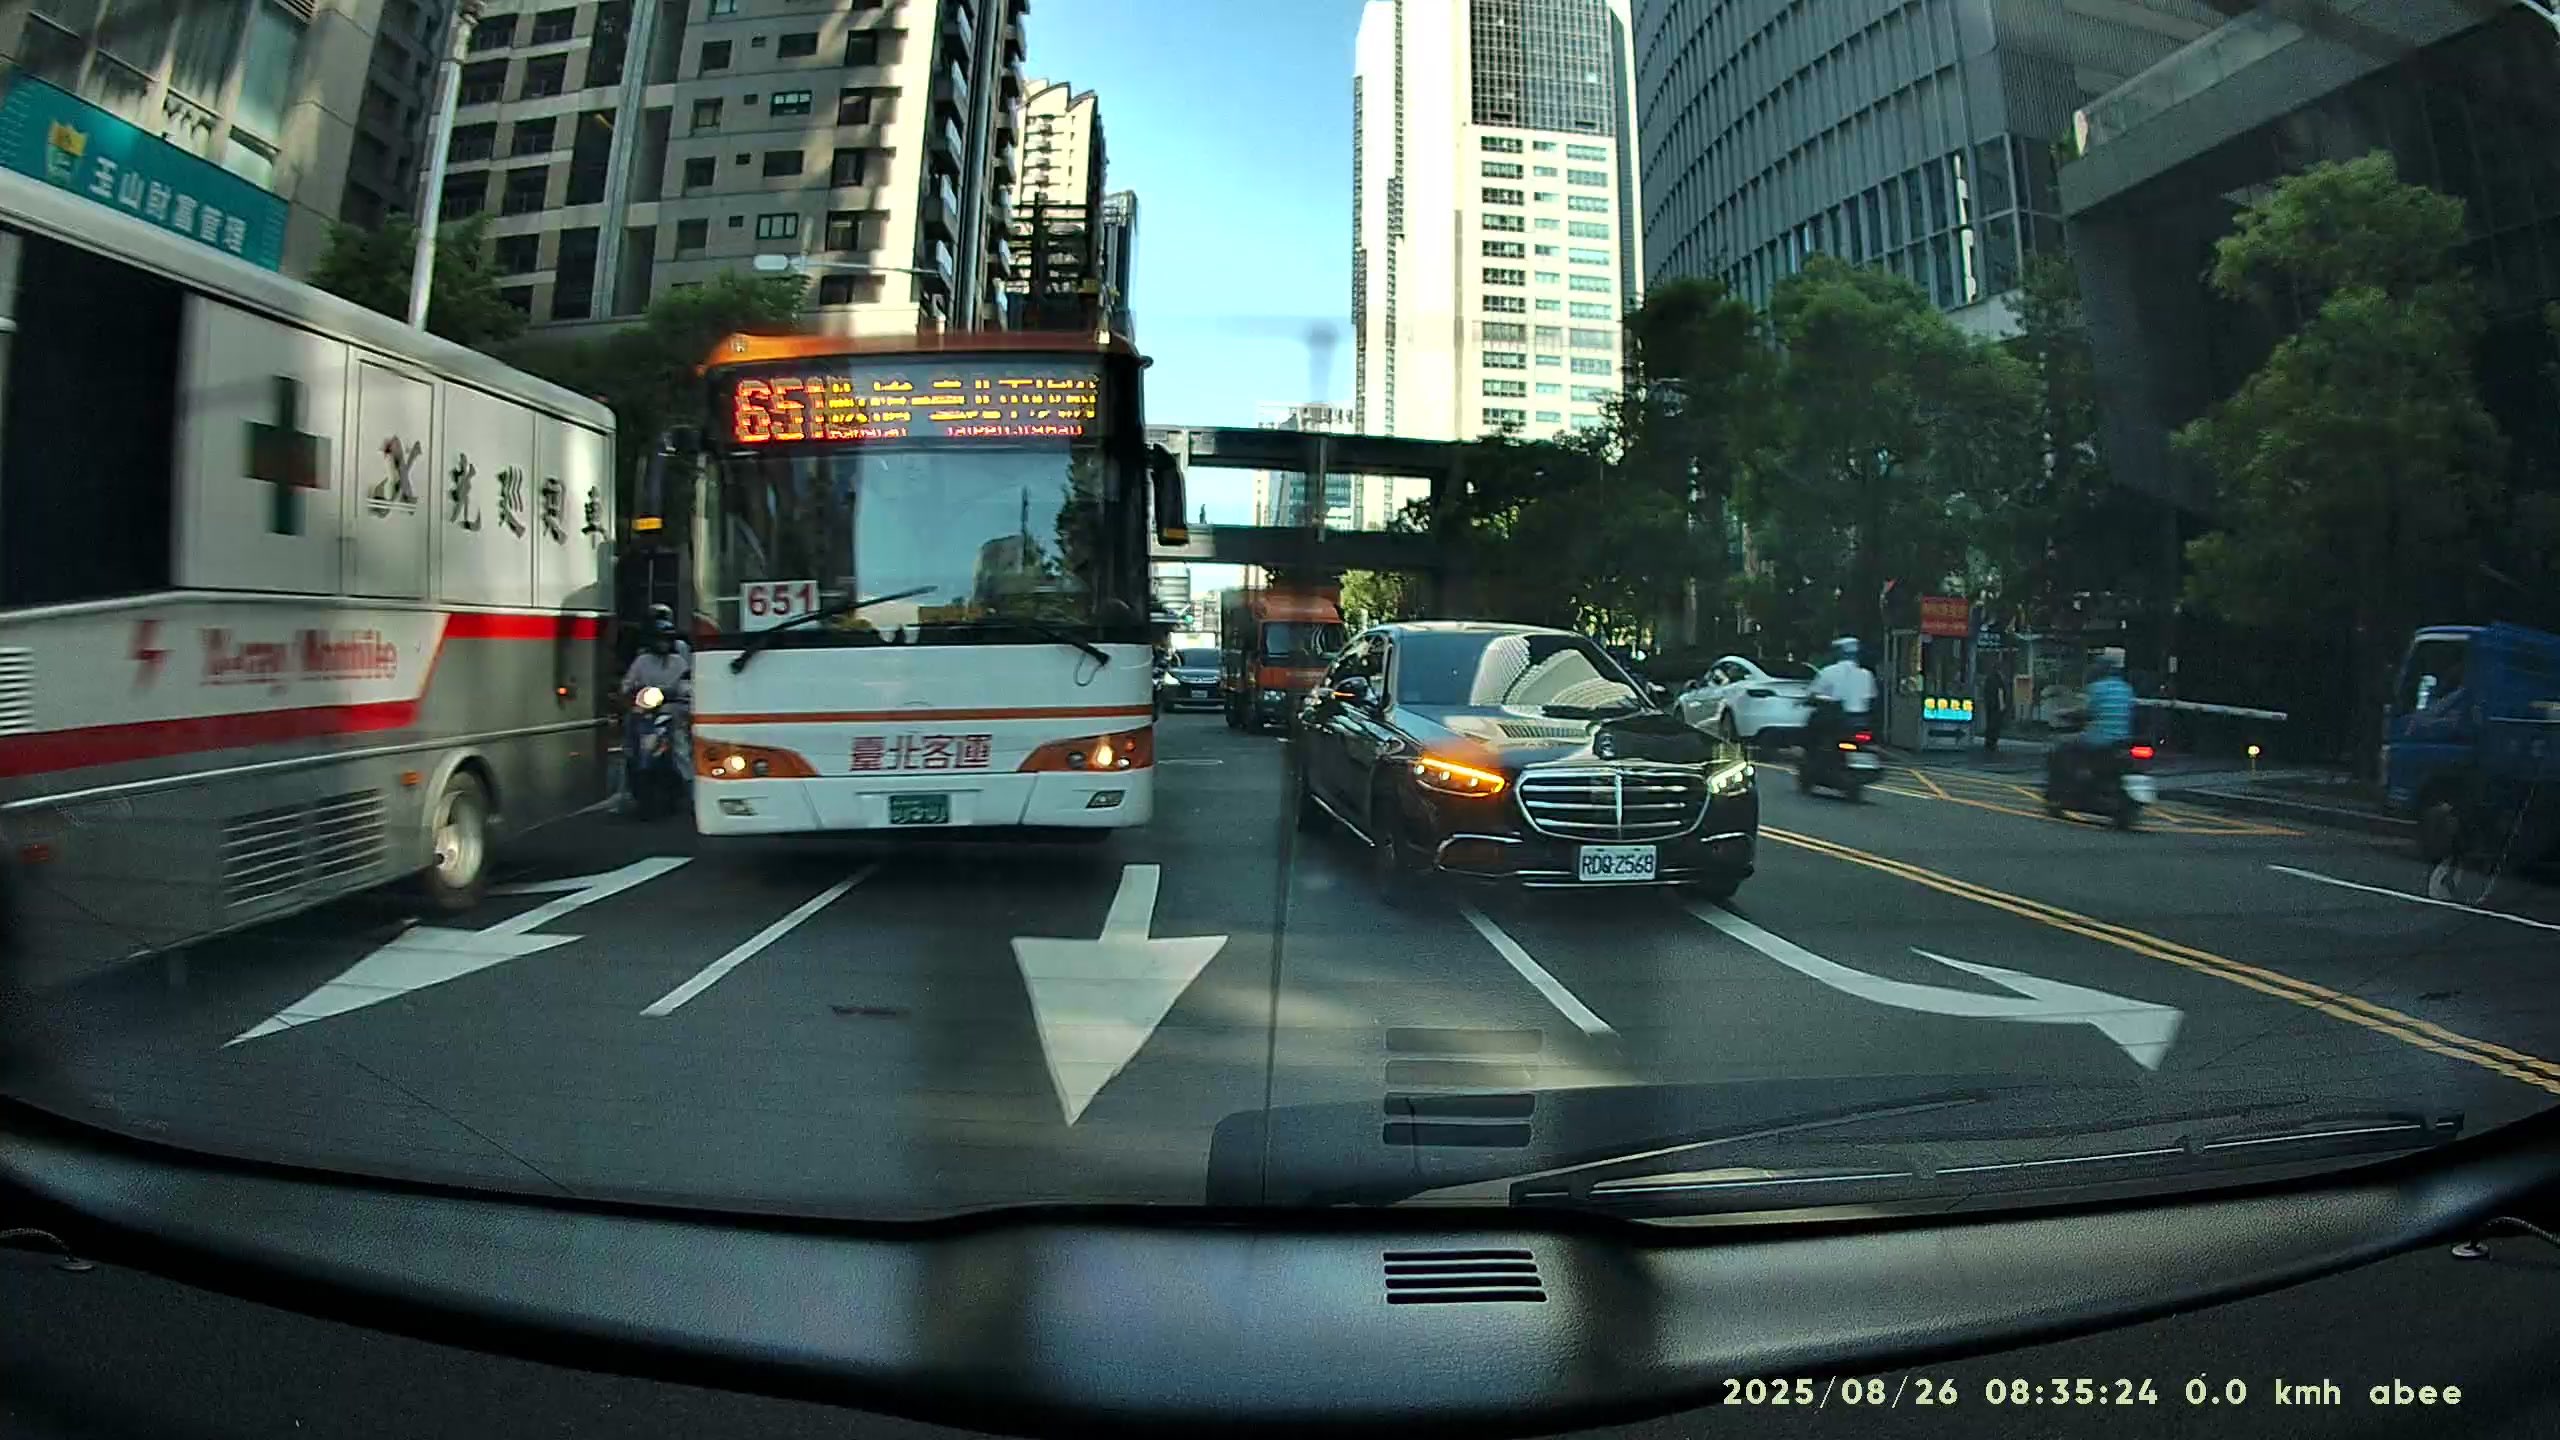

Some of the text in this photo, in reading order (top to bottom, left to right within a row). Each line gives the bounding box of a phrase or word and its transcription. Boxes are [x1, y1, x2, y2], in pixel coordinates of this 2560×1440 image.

[88, 155, 249, 254] 玉山財富管理
[749, 584, 814, 616] 651
[849, 734, 993, 771] 臺北客運
